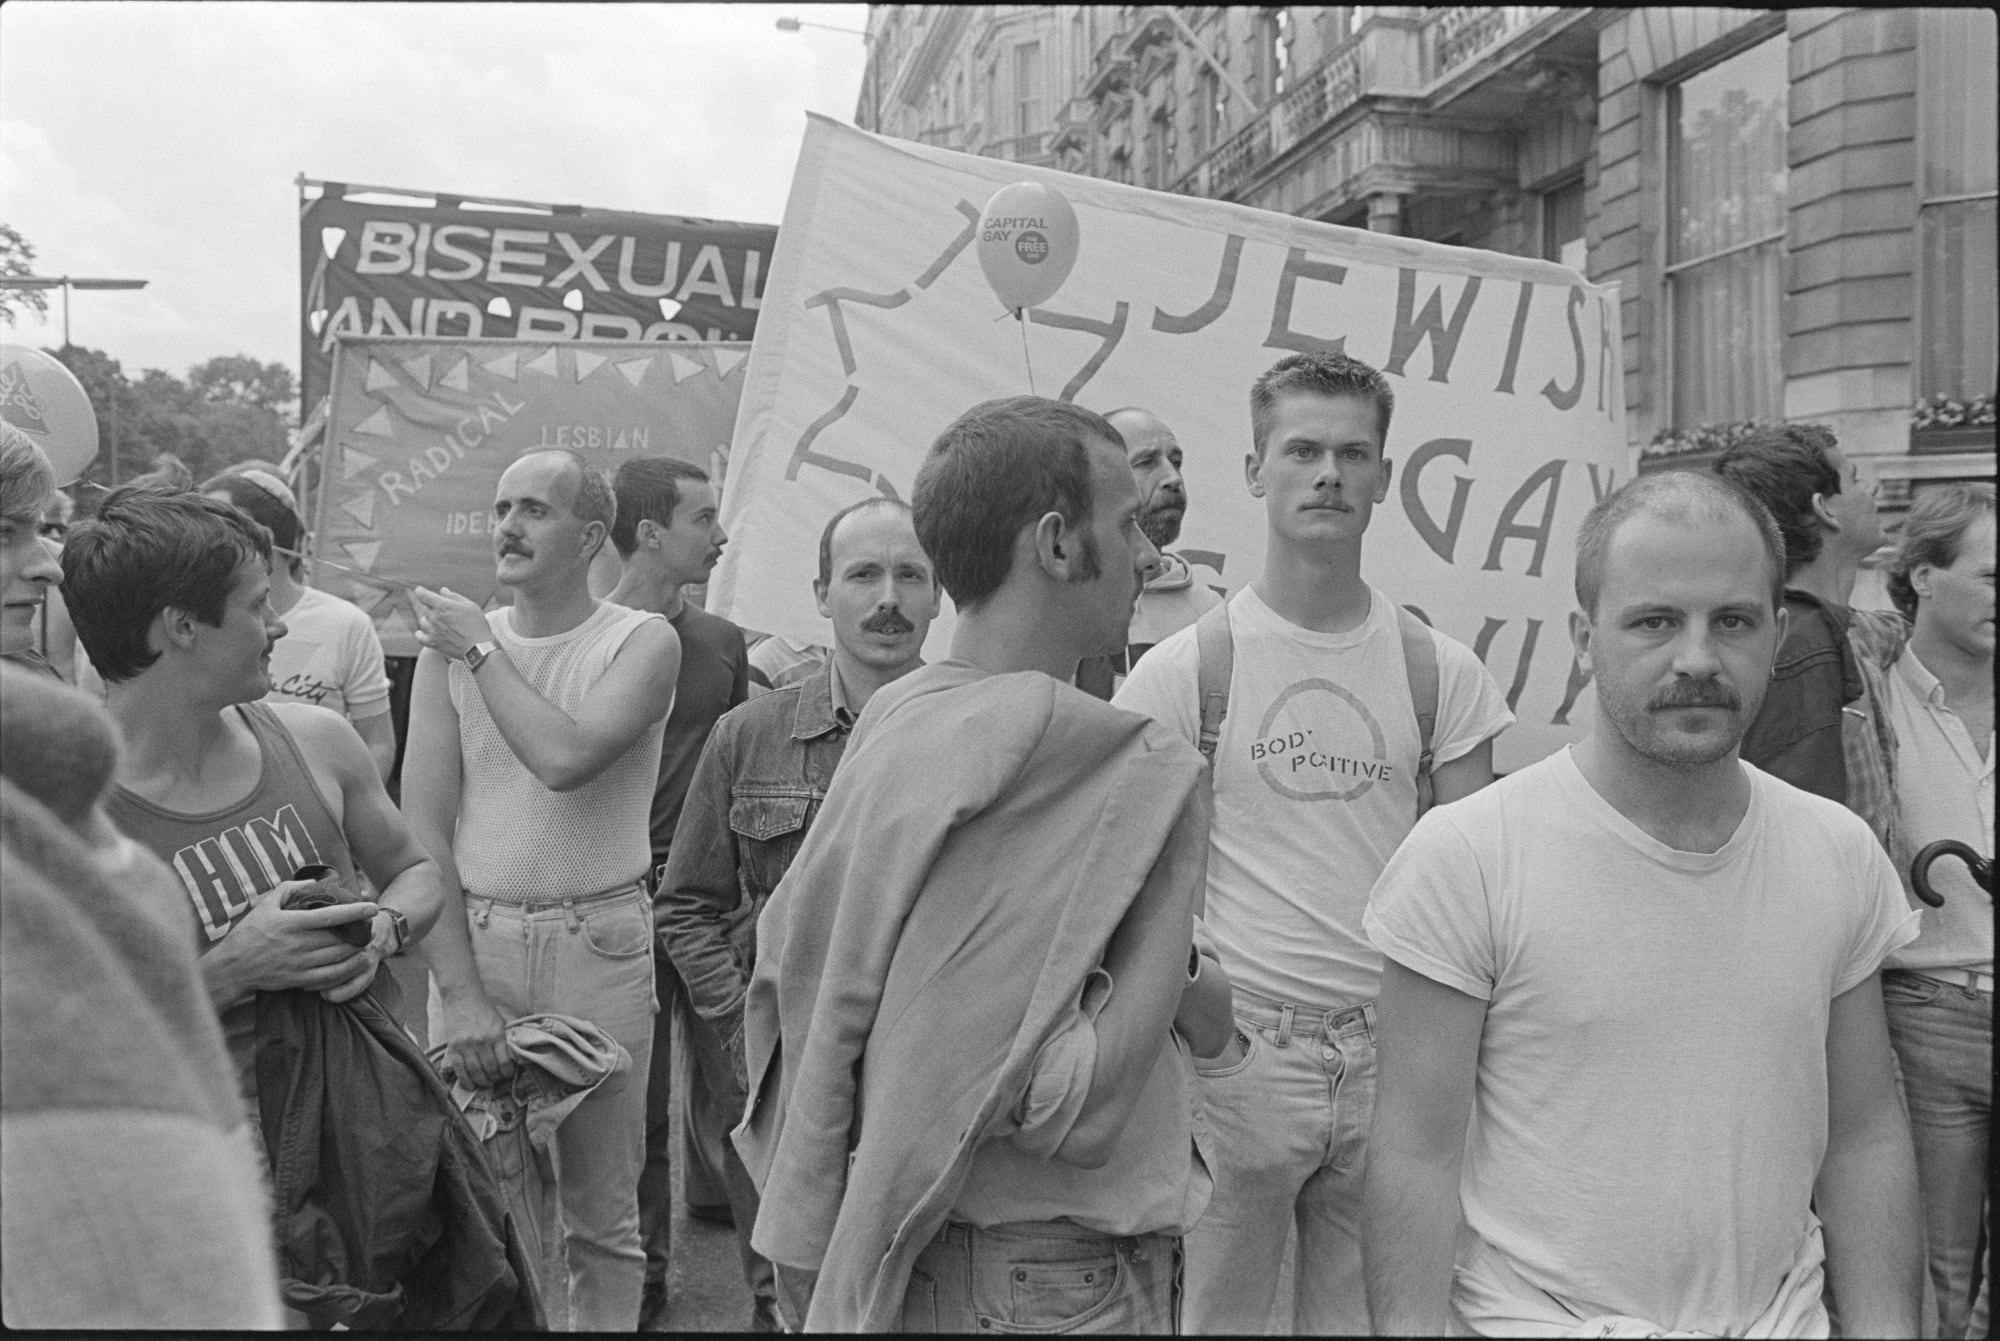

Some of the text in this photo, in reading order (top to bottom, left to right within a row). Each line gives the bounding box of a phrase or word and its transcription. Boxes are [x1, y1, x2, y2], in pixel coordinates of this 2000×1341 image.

[983, 230, 1011, 242] GAY
[984, 217, 1049, 230] CAPITAL
[1018, 242, 1048, 253] FREE
[356, 221, 770, 311] BISEXUAL
[1152, 233, 1615, 423] JEWISH
[378, 390, 526, 505] RADICAL
[541, 426, 650, 450] LESBIAN
[1251, 730, 1312, 760] BOD
[173, 803, 323, 942] HIM
